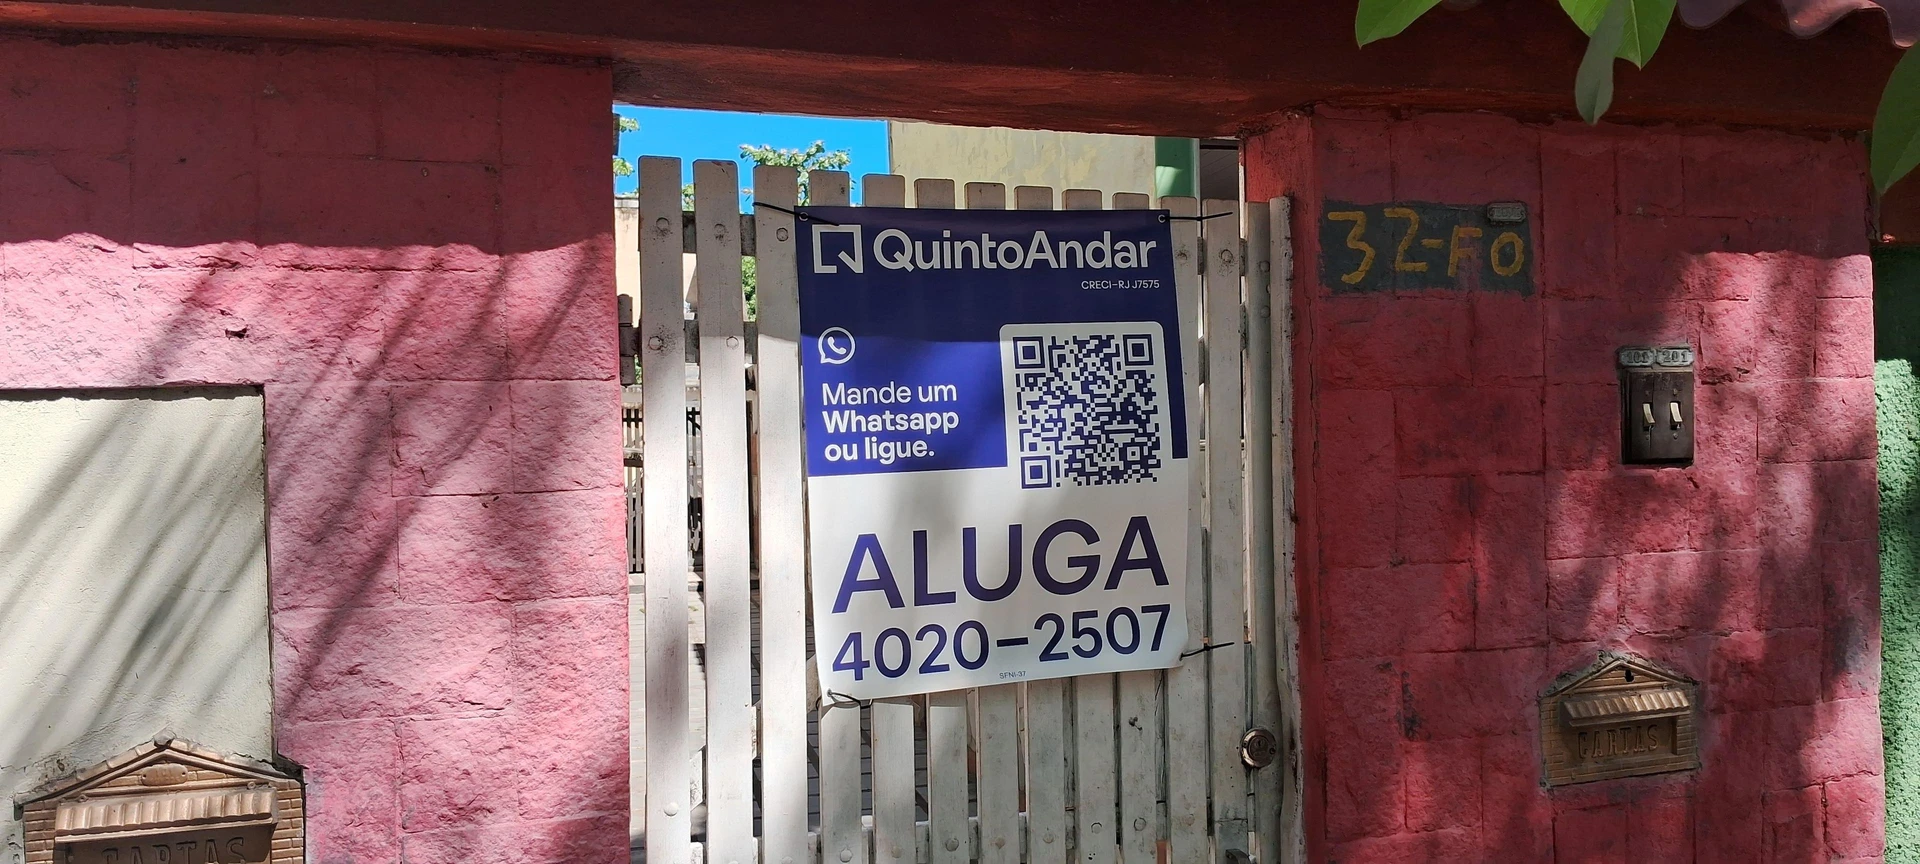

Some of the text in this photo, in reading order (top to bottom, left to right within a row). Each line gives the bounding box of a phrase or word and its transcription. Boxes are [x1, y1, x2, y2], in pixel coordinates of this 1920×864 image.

[873, 228, 1157, 273] QuintoAndar
[1081, 279, 1160, 290] CRECI-RJ J7575
[1662, 349, 1688, 363] 201
[822, 381, 957, 406] Mande um
[822, 410, 960, 435] Whatsapp
[824, 437, 935, 465] ou ligue.
[831, 515, 1170, 614] ALUGA
[832, 603, 1171, 682] 4020-2507
[1577, 724, 1659, 760] CARTAS
